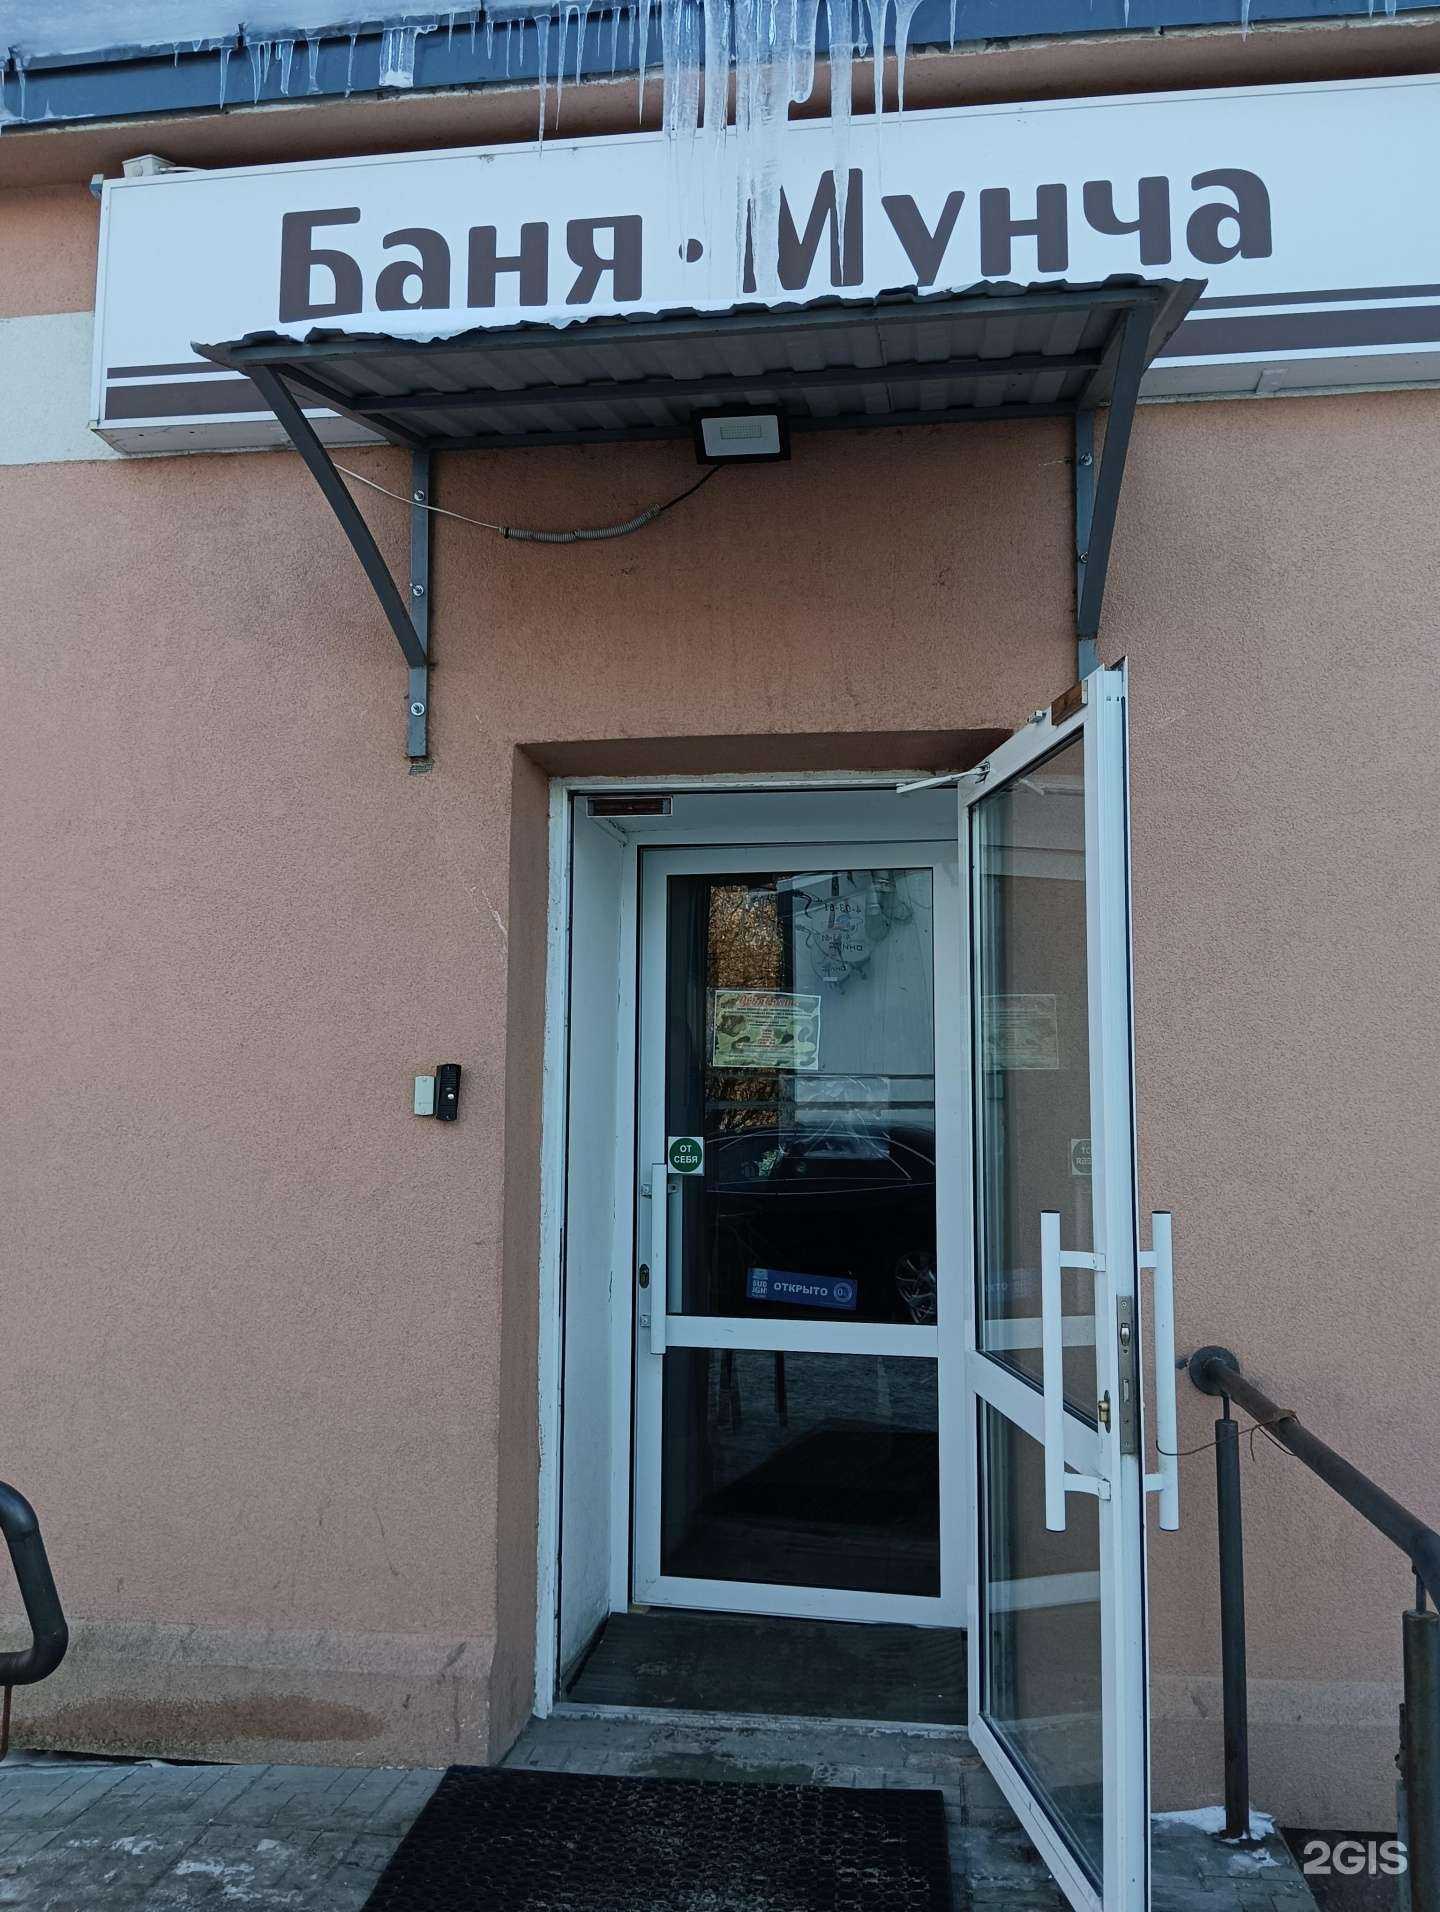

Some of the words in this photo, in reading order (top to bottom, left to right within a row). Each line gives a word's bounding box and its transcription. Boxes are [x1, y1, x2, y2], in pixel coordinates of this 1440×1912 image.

[278, 206, 643, 324] Баня
[742, 166, 1273, 294] Мунча
[679, 1144, 692, 1153] ОТ
[673, 1155, 698, 1164] СЕБЯ
[773, 1281, 829, 1297] ОТКРЫТО
